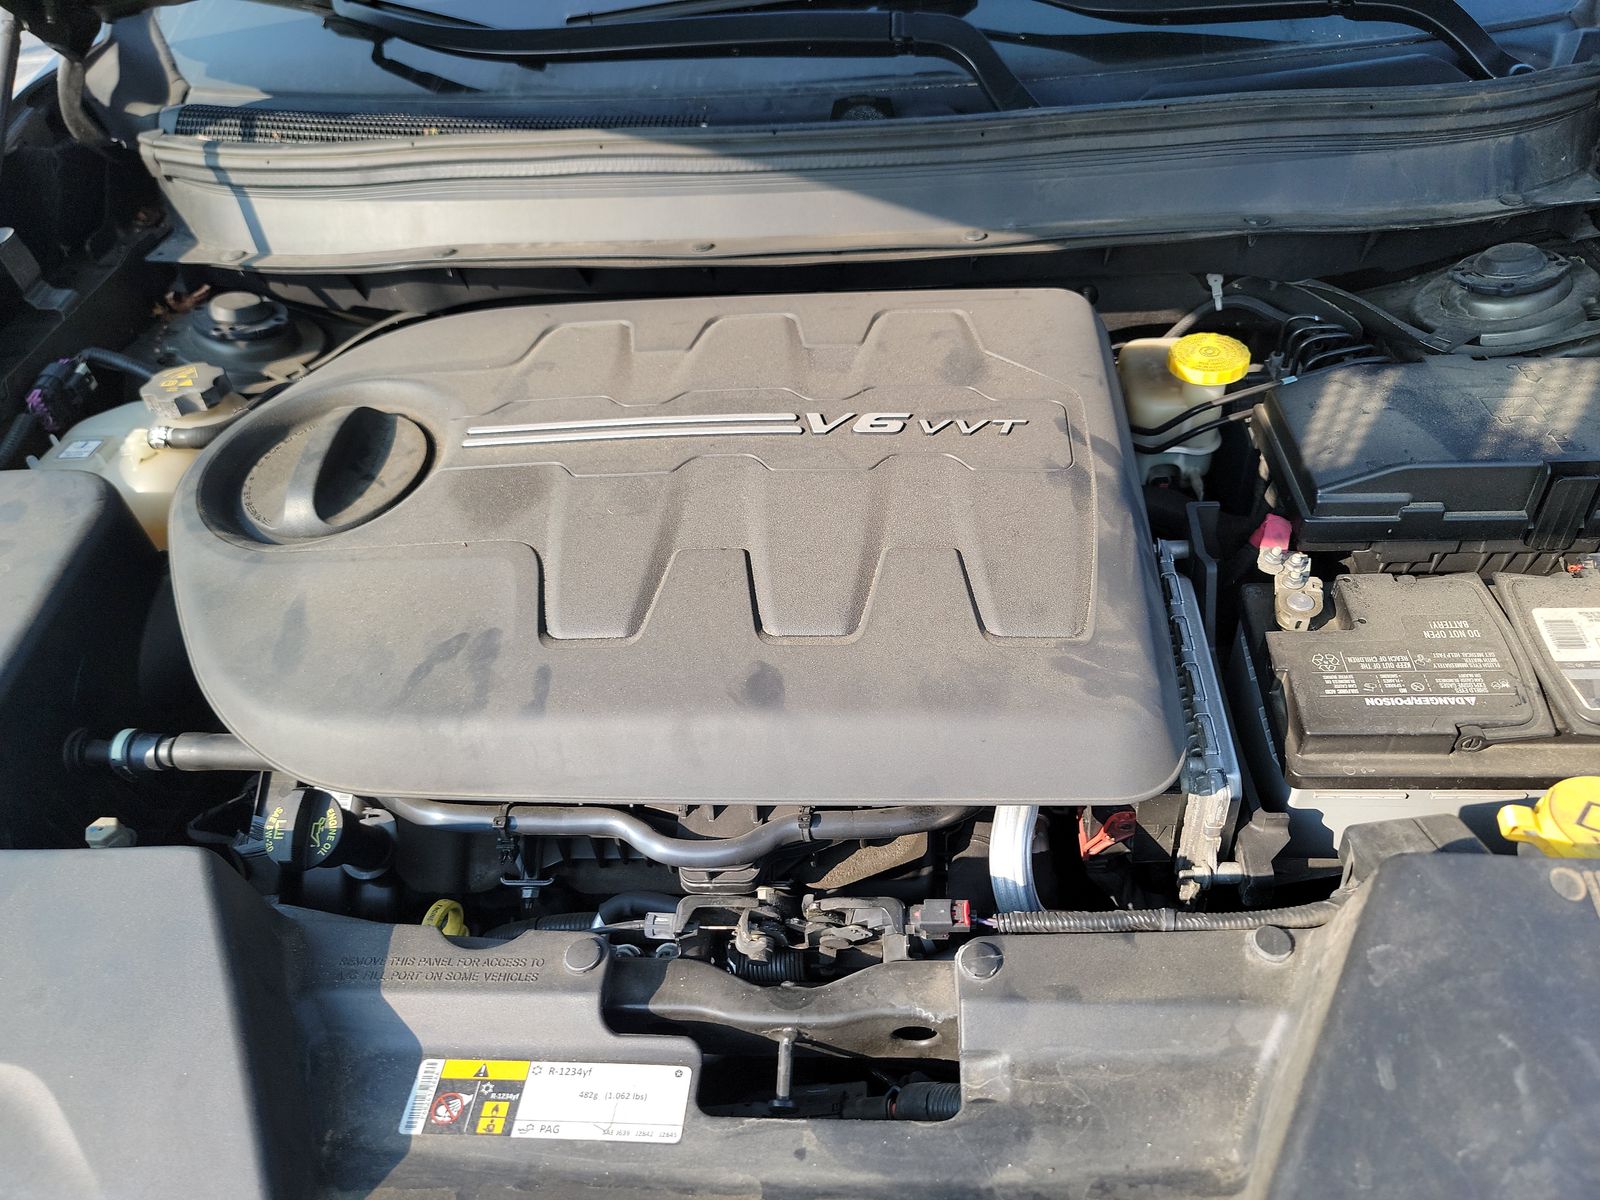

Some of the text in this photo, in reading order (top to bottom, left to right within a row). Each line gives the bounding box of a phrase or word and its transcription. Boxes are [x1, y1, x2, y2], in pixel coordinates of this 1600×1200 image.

[805, 412, 1030, 436] V6 VVT
[1429, 620, 1470, 629] BATTERY!
[1423, 629, 1481, 639] DO NOT OPEN
[1396, 661, 1412, 669] KEEP
[1364, 696, 1466, 706] DANGER/POISON
[268, 806, 284, 824] SAE
[317, 808, 338, 856] ENGINE OIL
[338, 956, 545, 968] REMOVE THIS PANEL FOR ACCESS TO
[391, 970, 423, 982] PORT
[424, 971, 443, 981] ON
[445, 971, 480, 982] SOME
[483, 972, 540, 983] VEHICLES
[548, 1066, 593, 1079] R-1234yf
[578, 1091, 599, 1101] 482g
[604, 1092, 631, 1101] (1.062
[539, 1124, 561, 1134] PAG
